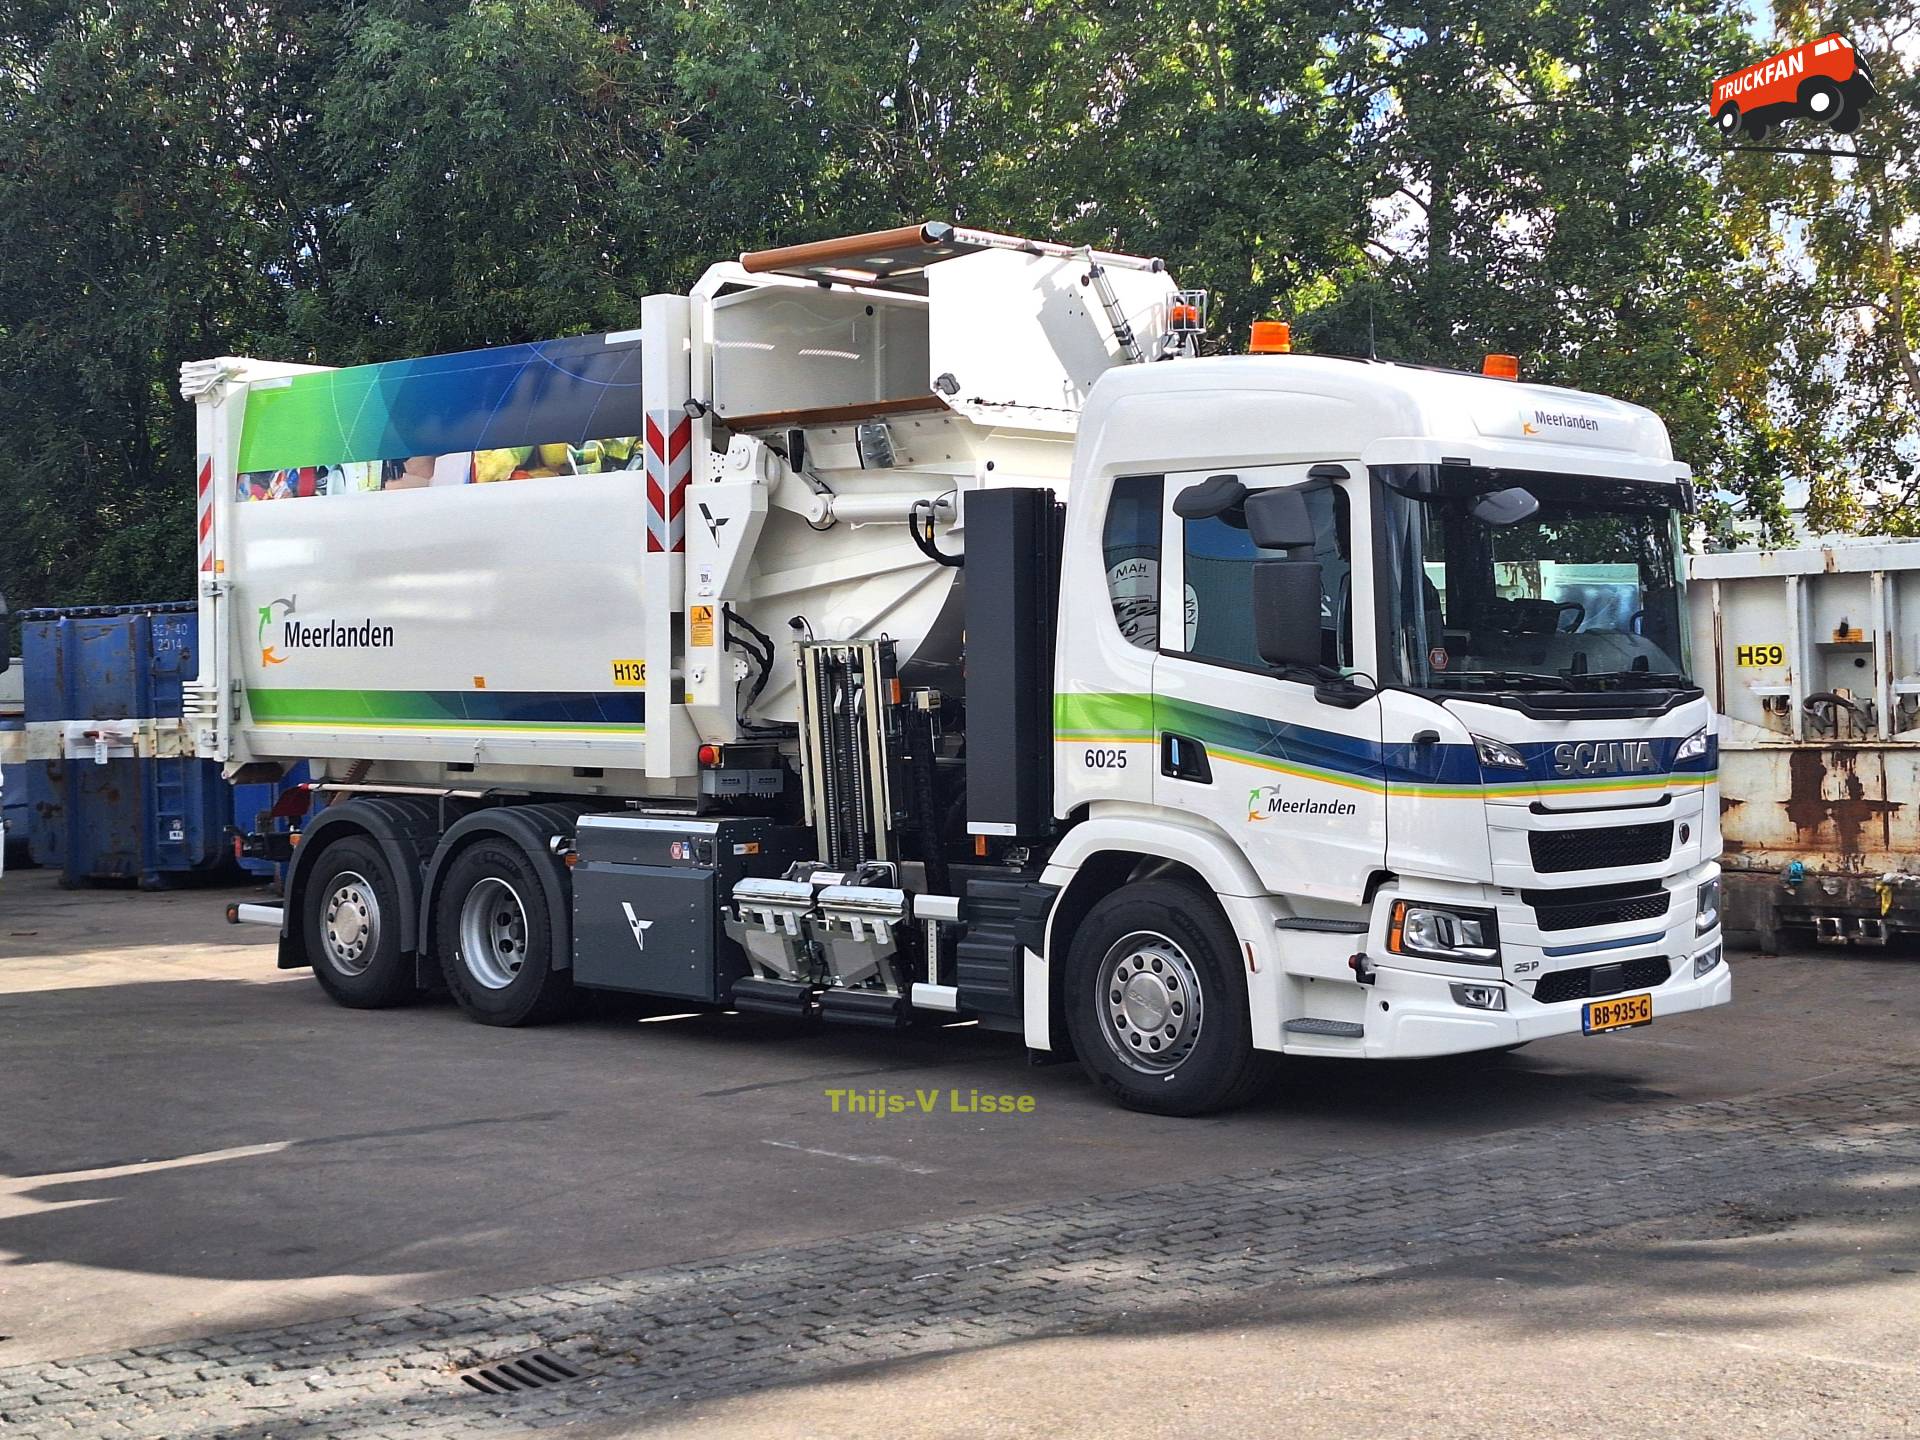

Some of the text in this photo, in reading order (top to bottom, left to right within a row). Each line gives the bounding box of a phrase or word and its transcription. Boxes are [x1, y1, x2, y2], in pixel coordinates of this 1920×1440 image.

[1534, 410, 1599, 431] Meerlanden
[284, 618, 394, 648] Meerlanden
[1737, 645, 1783, 665] H59
[1085, 749, 1128, 769] 6025
[1554, 741, 1656, 775] SCANIA
[1268, 798, 1356, 816] Meerlanden
[1594, 999, 1648, 1026] BB-935-G
